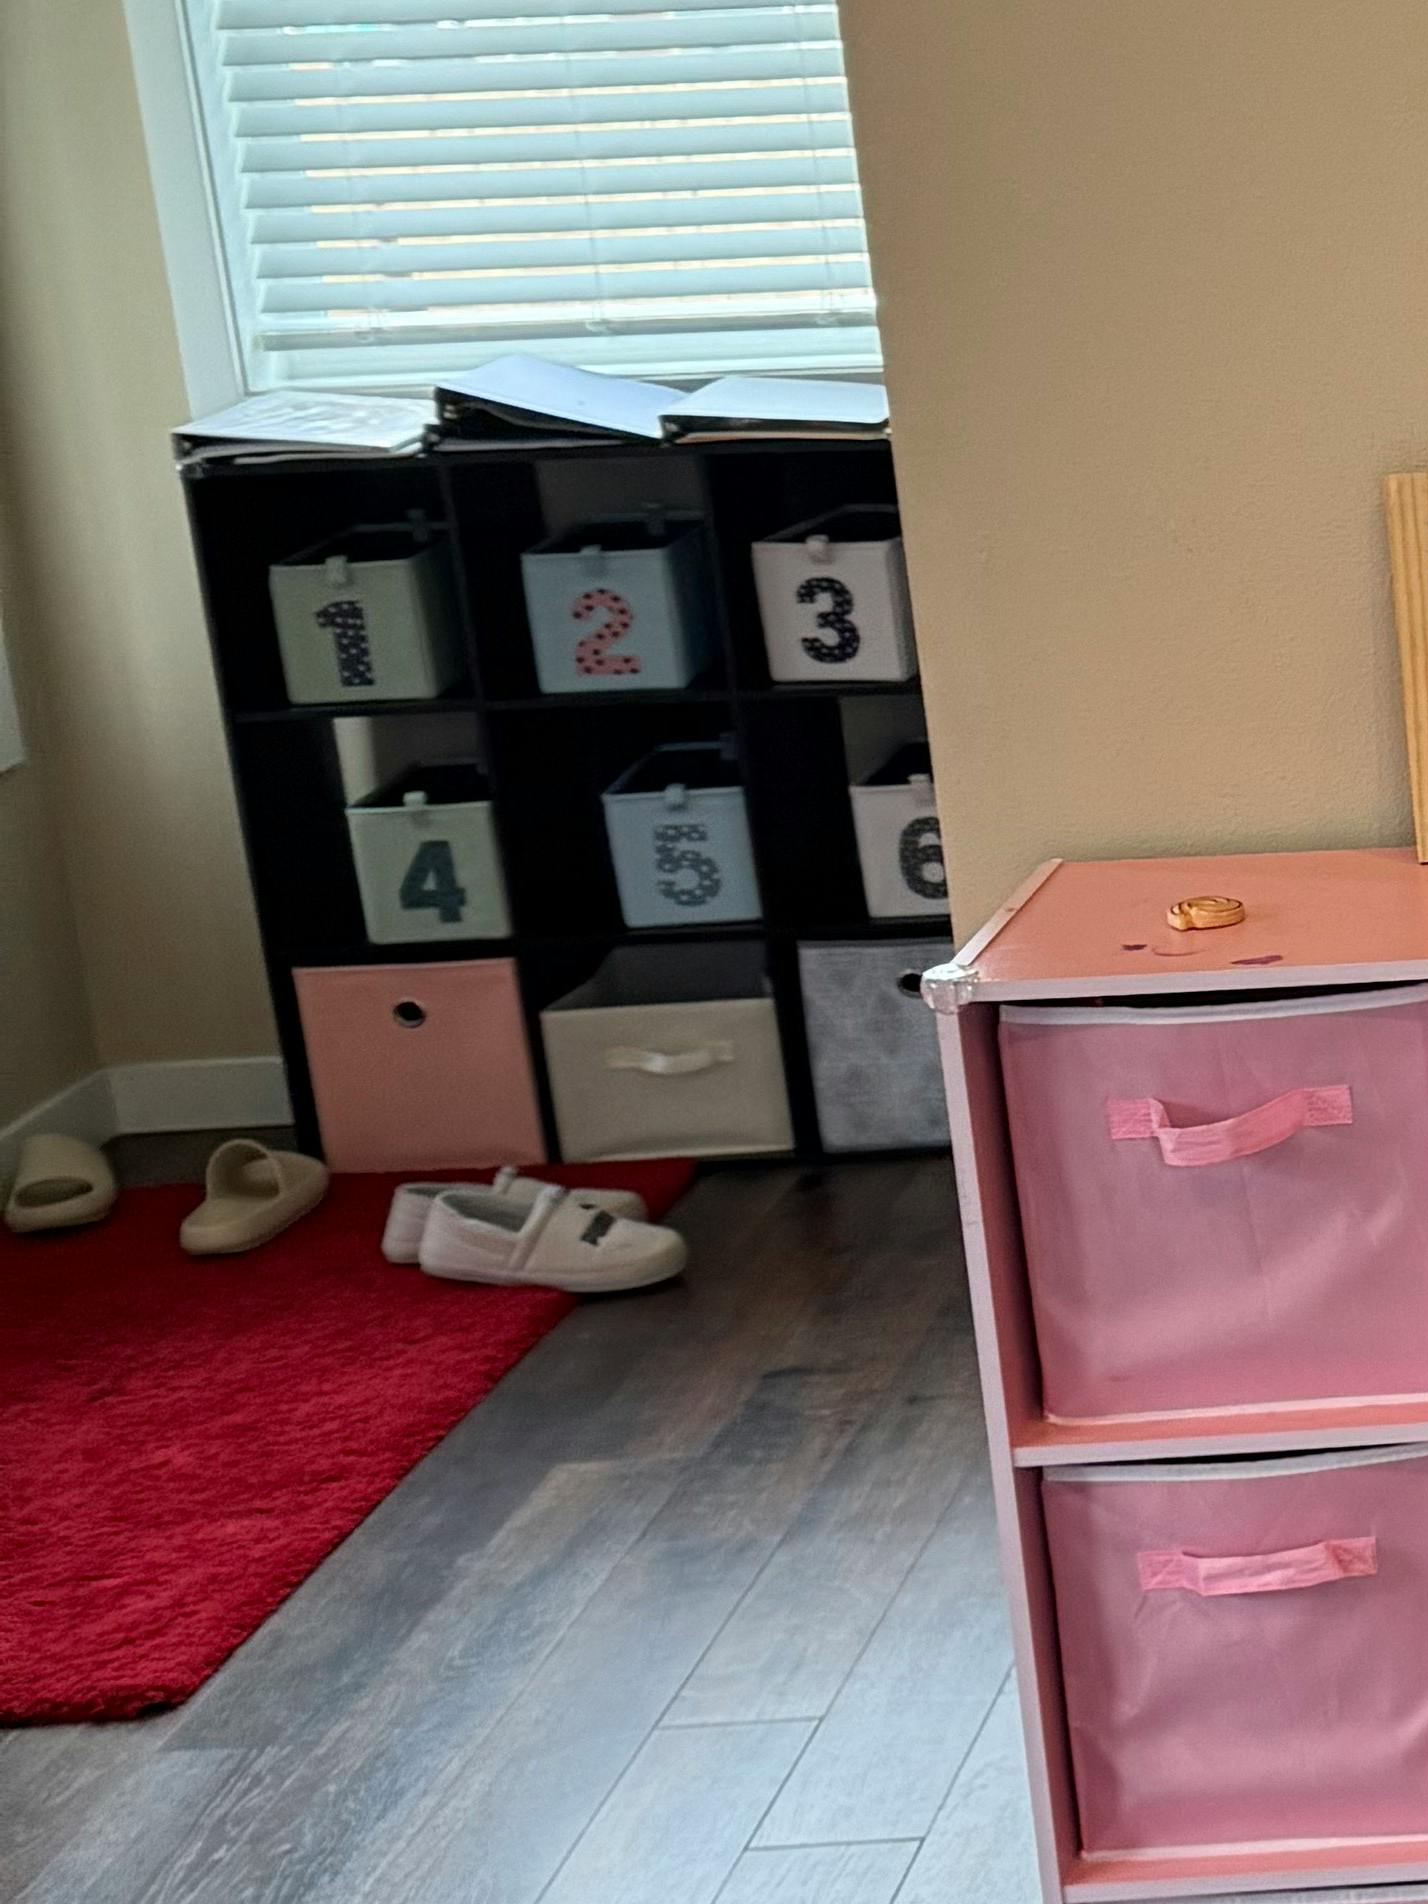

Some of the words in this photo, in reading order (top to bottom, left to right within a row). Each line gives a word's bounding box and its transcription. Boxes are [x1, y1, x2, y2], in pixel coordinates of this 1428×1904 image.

[315, 598, 375, 686] 1
[573, 588, 641, 675] 2
[796, 576, 861, 664] 3
[399, 839, 466, 922] 4
[654, 823, 722, 907] 5
[899, 816, 949, 900] 6
